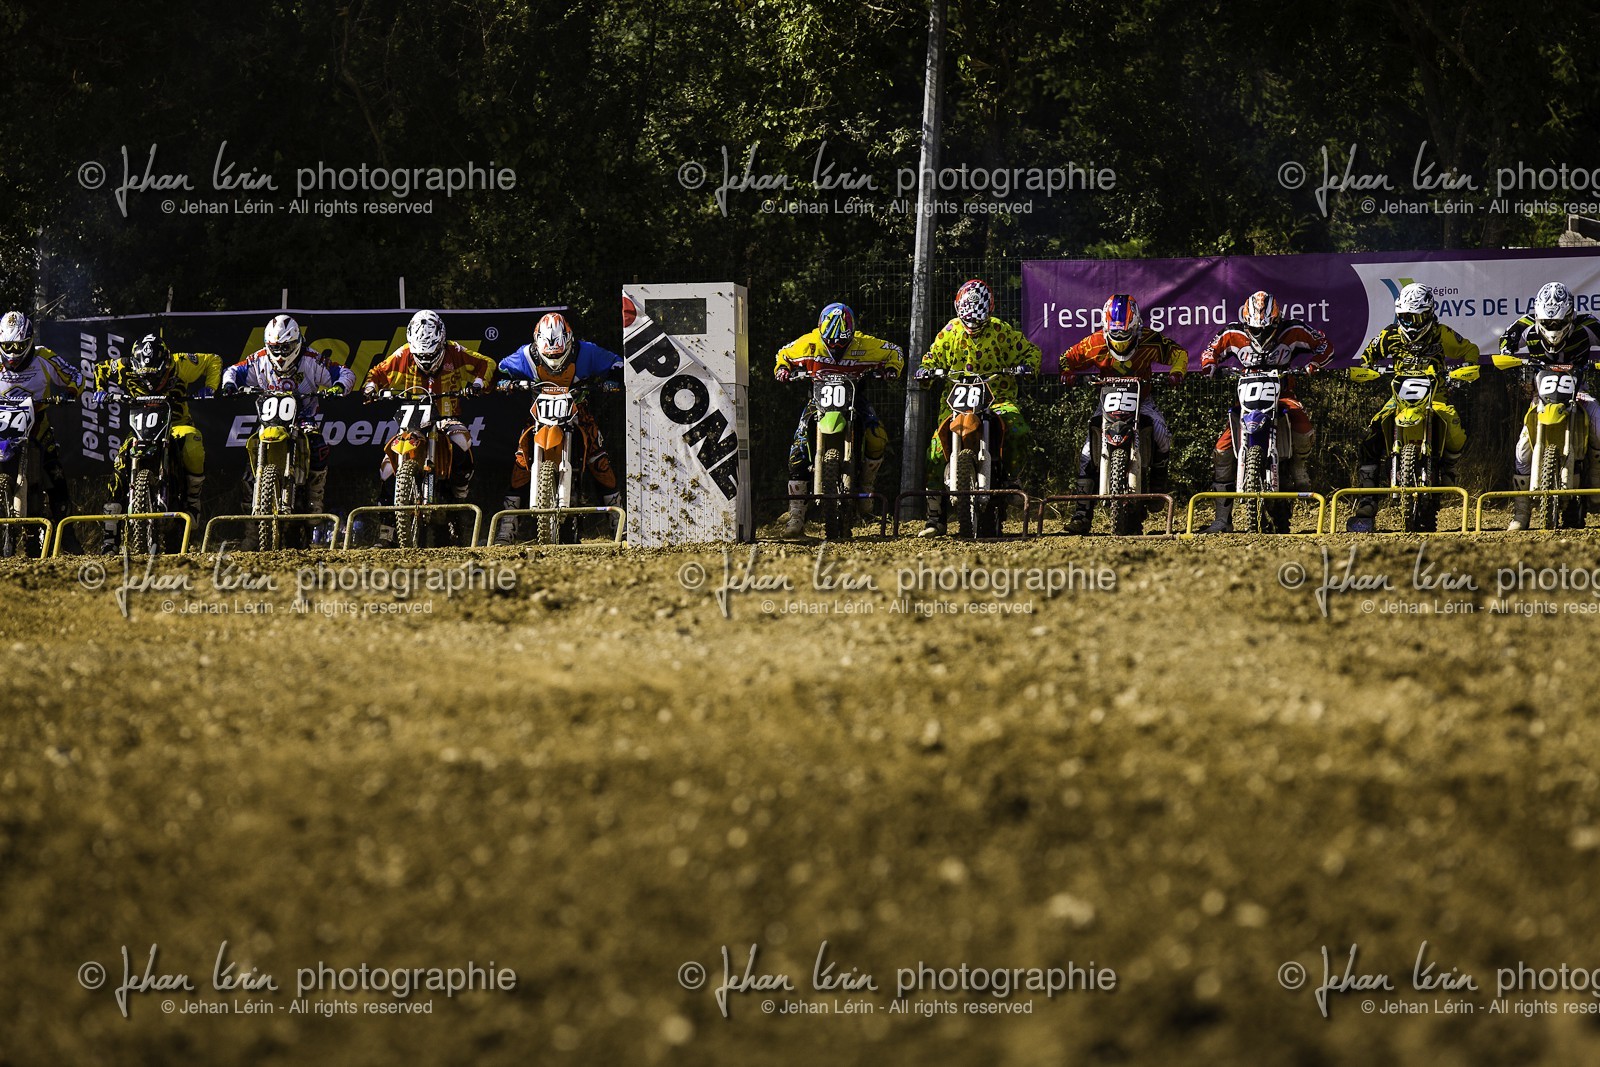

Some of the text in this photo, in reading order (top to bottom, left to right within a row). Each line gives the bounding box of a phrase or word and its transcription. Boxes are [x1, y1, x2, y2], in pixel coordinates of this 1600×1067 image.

[1150, 299, 1226, 332] grand
[1483, 298, 1508, 316] DE
[1515, 297, 1535, 315] LA
[1238, 382, 1280, 402] 102
[1398, 378, 1431, 400] 6
[1538, 375, 1577, 395] 69
[820, 385, 846, 407] 30
[953, 386, 980, 408] 26
[1103, 392, 1138, 412] 65
[261, 397, 296, 422] 90
[400, 404, 432, 429] 77
[538, 399, 567, 418] 110
[134, 412, 159, 431] 10
